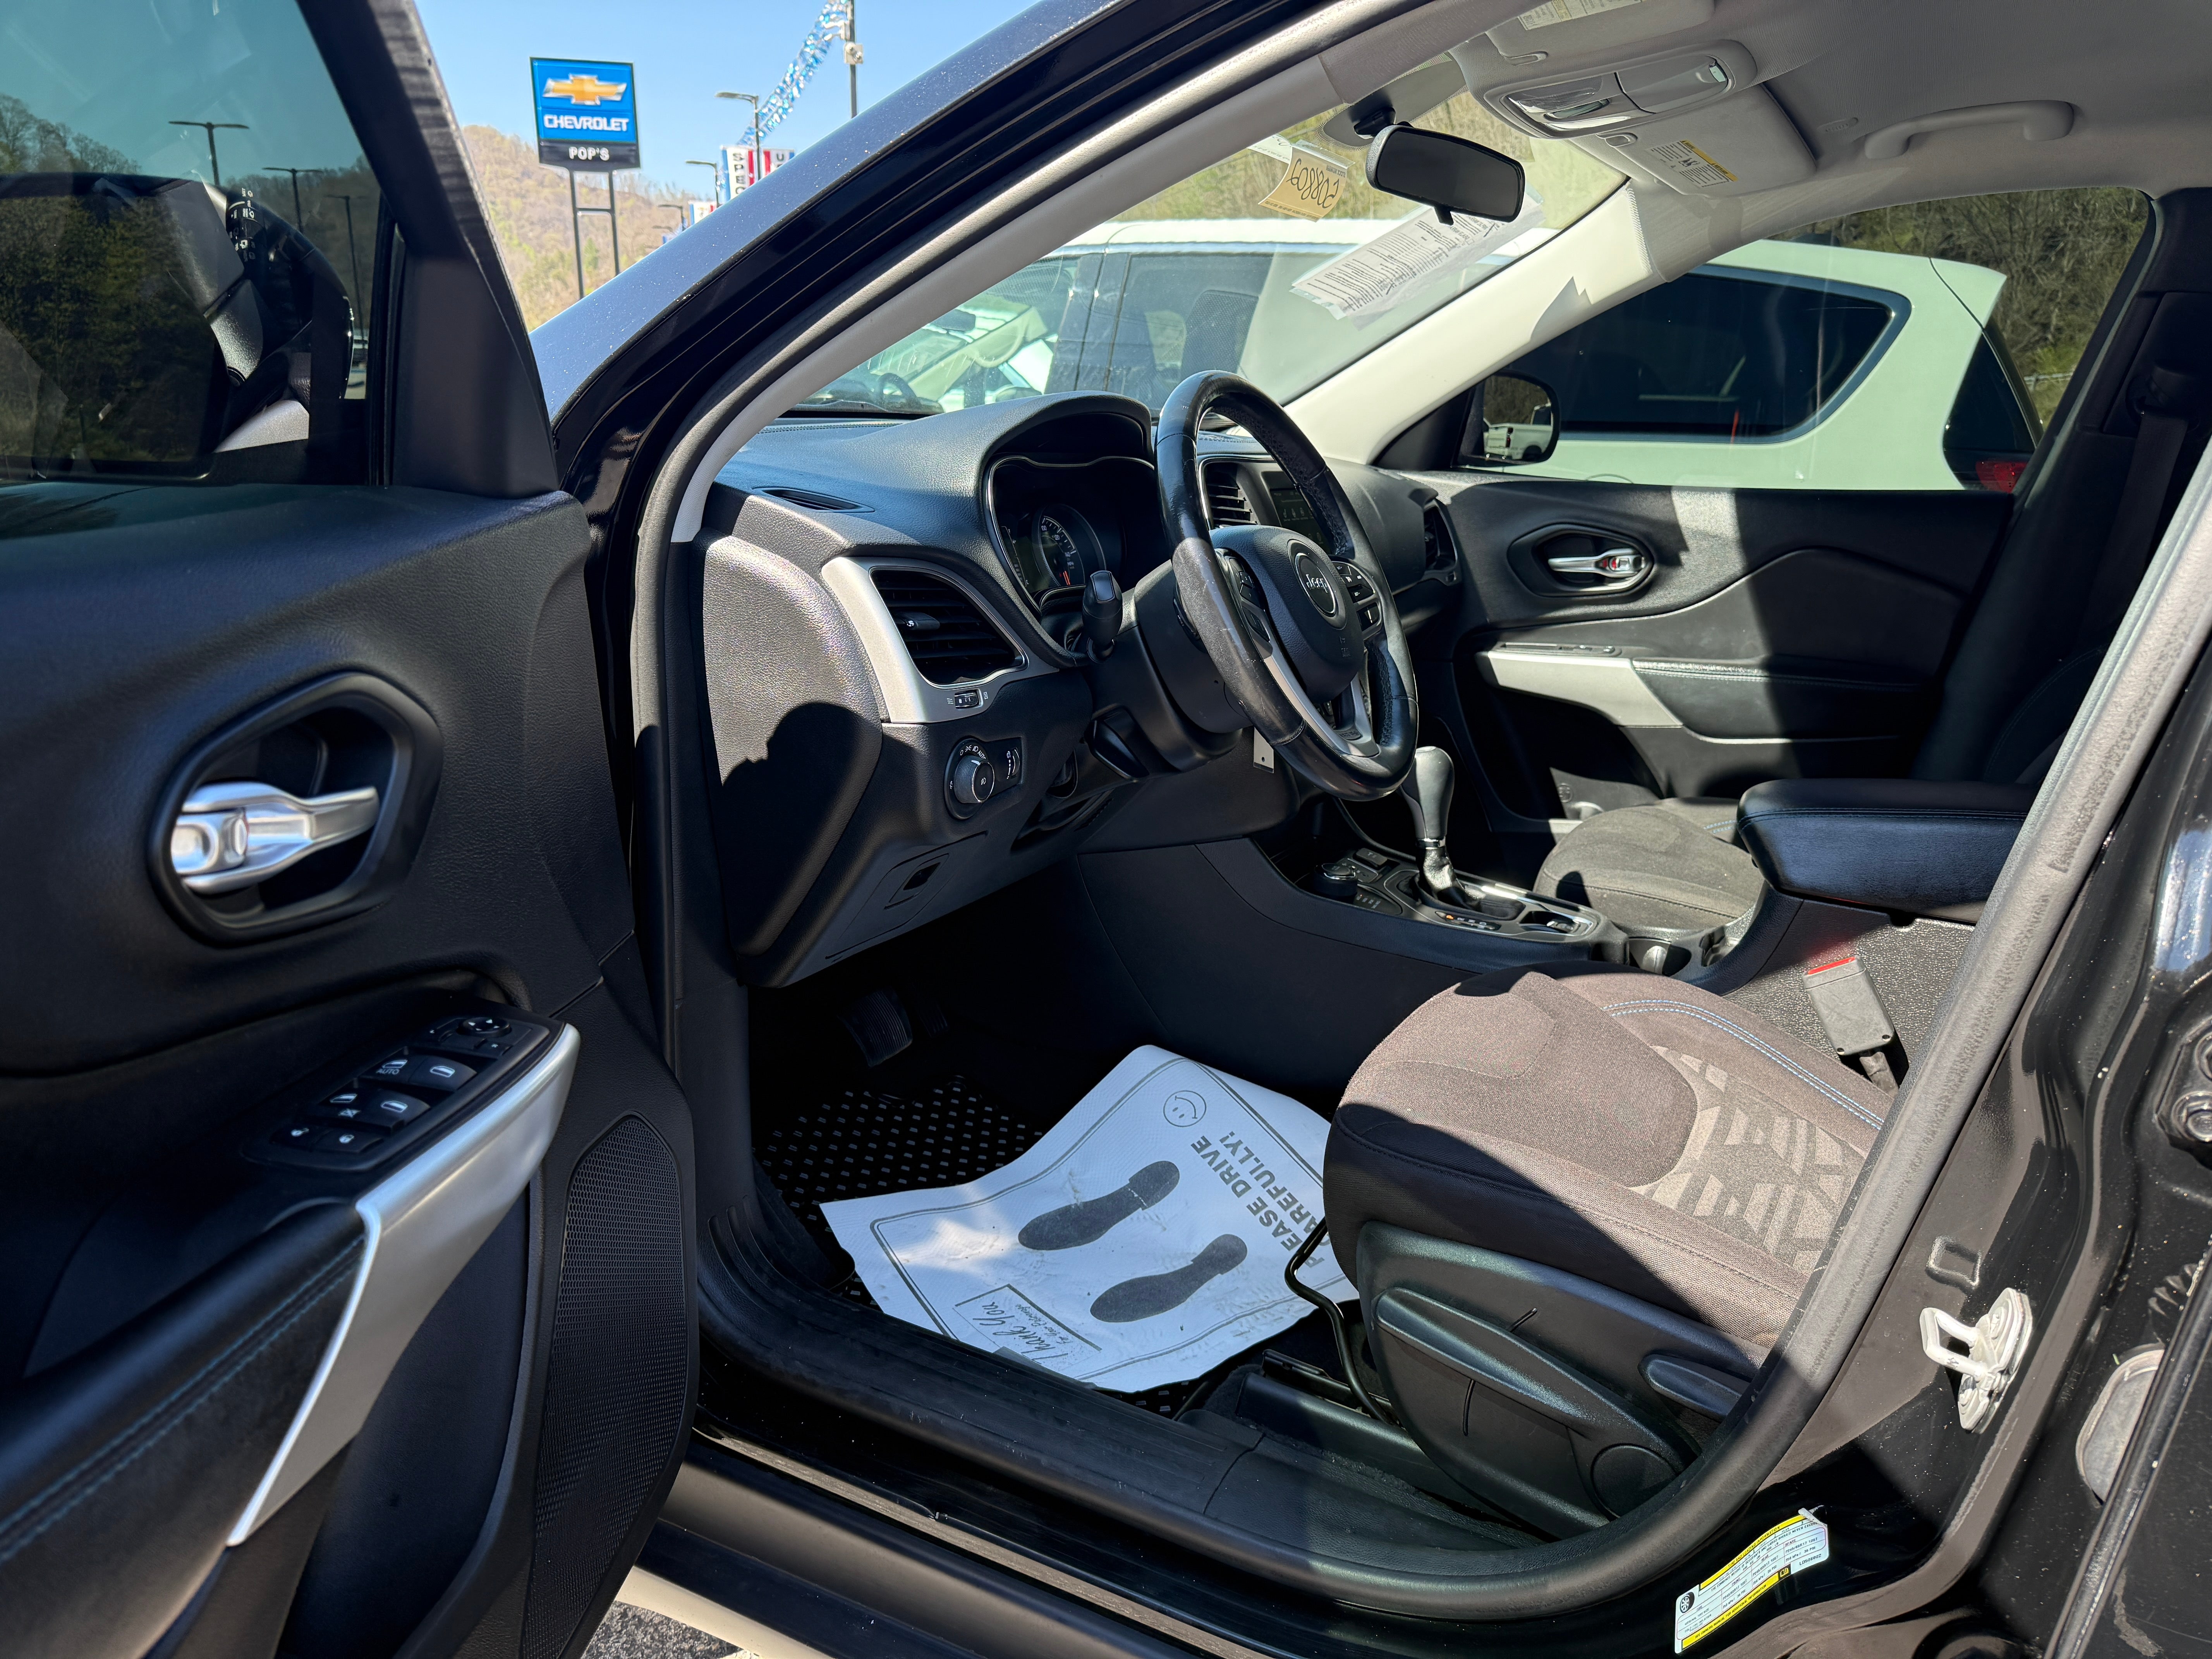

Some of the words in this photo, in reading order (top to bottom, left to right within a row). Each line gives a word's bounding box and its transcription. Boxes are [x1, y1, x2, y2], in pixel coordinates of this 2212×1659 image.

[543, 114, 629, 131] CHEVROLET
[568, 146, 610, 161] POP'S
[1306, 574, 1328, 594] Jeep
[1191, 1135, 1252, 1198] DRIVE
[972, 1302, 1015, 1326] You
[993, 1326, 1068, 1365] Thank
